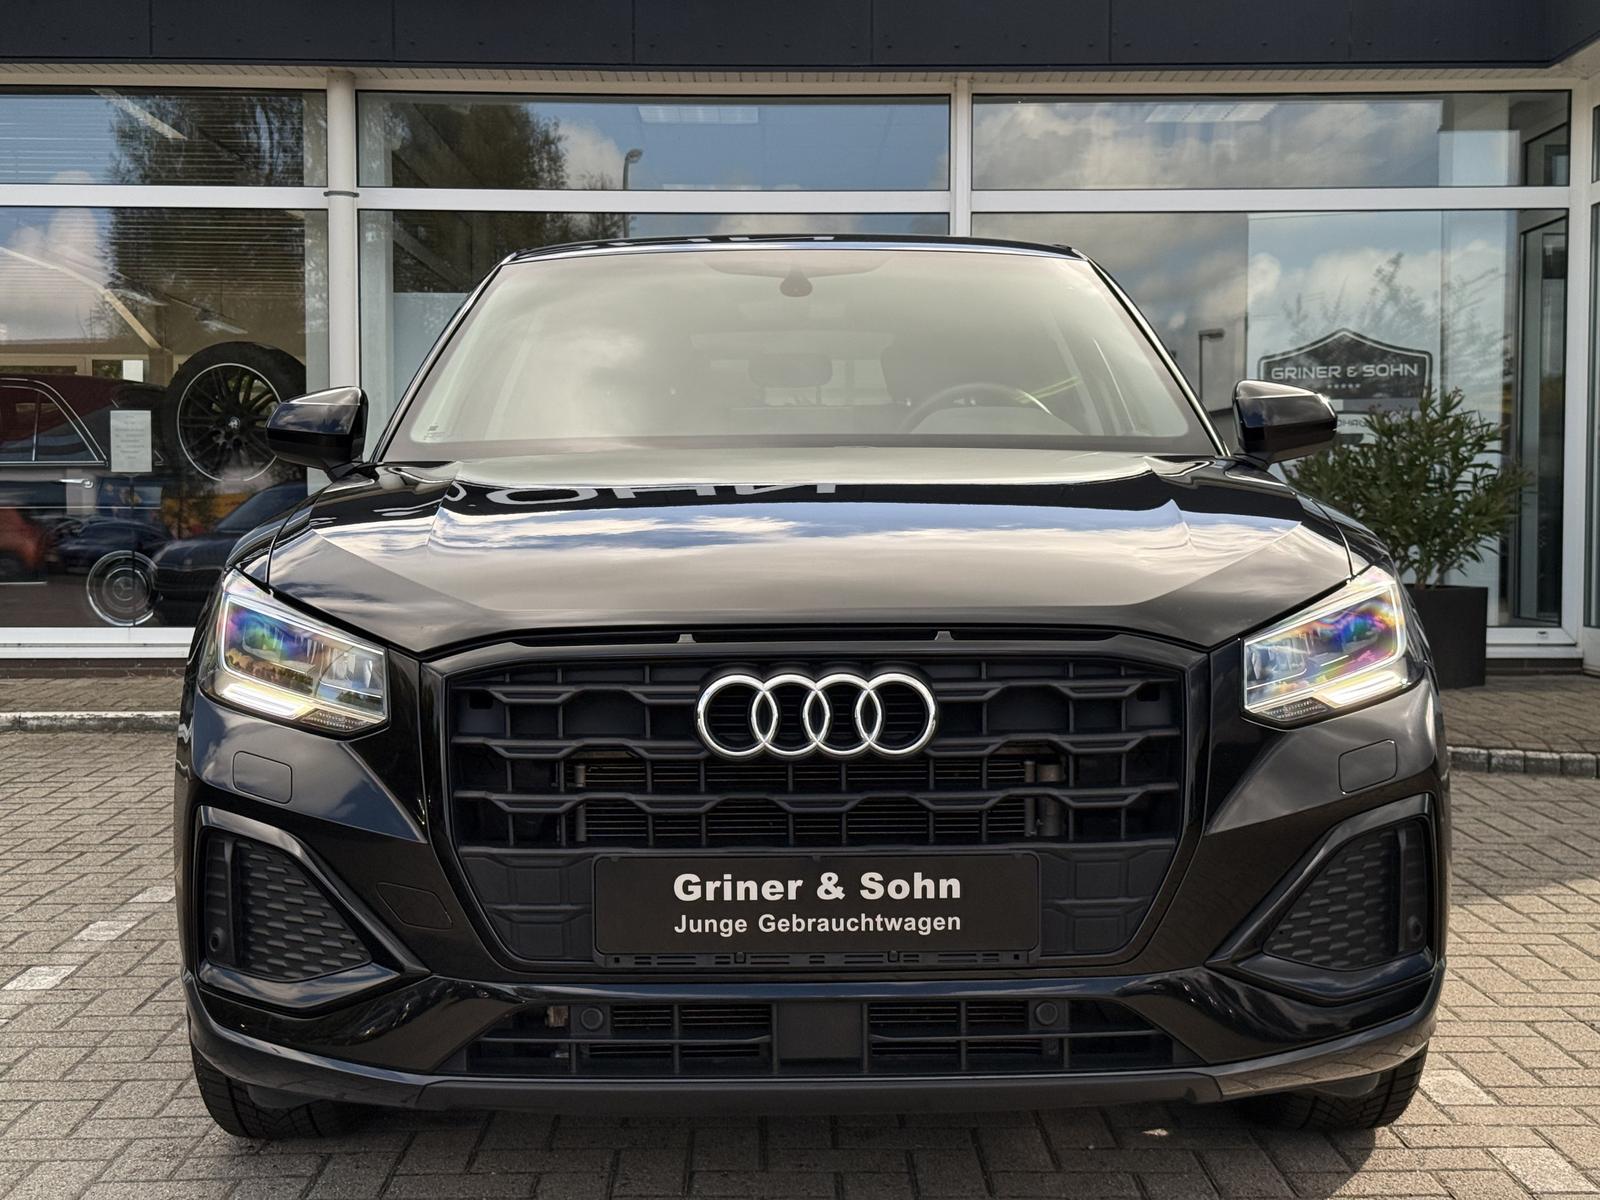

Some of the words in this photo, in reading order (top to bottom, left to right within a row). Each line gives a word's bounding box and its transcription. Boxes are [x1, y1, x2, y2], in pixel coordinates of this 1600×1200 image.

[1271, 365, 1341, 380] GRINER
[1346, 367, 1357, 378] &
[1362, 363, 1418, 377] SOHN
[673, 872, 803, 901] Griner
[816, 871, 846, 900] &
[859, 871, 961, 899] Sohn
[673, 913, 748, 938] Junge
[758, 912, 962, 936] Gebrauchtwagen
